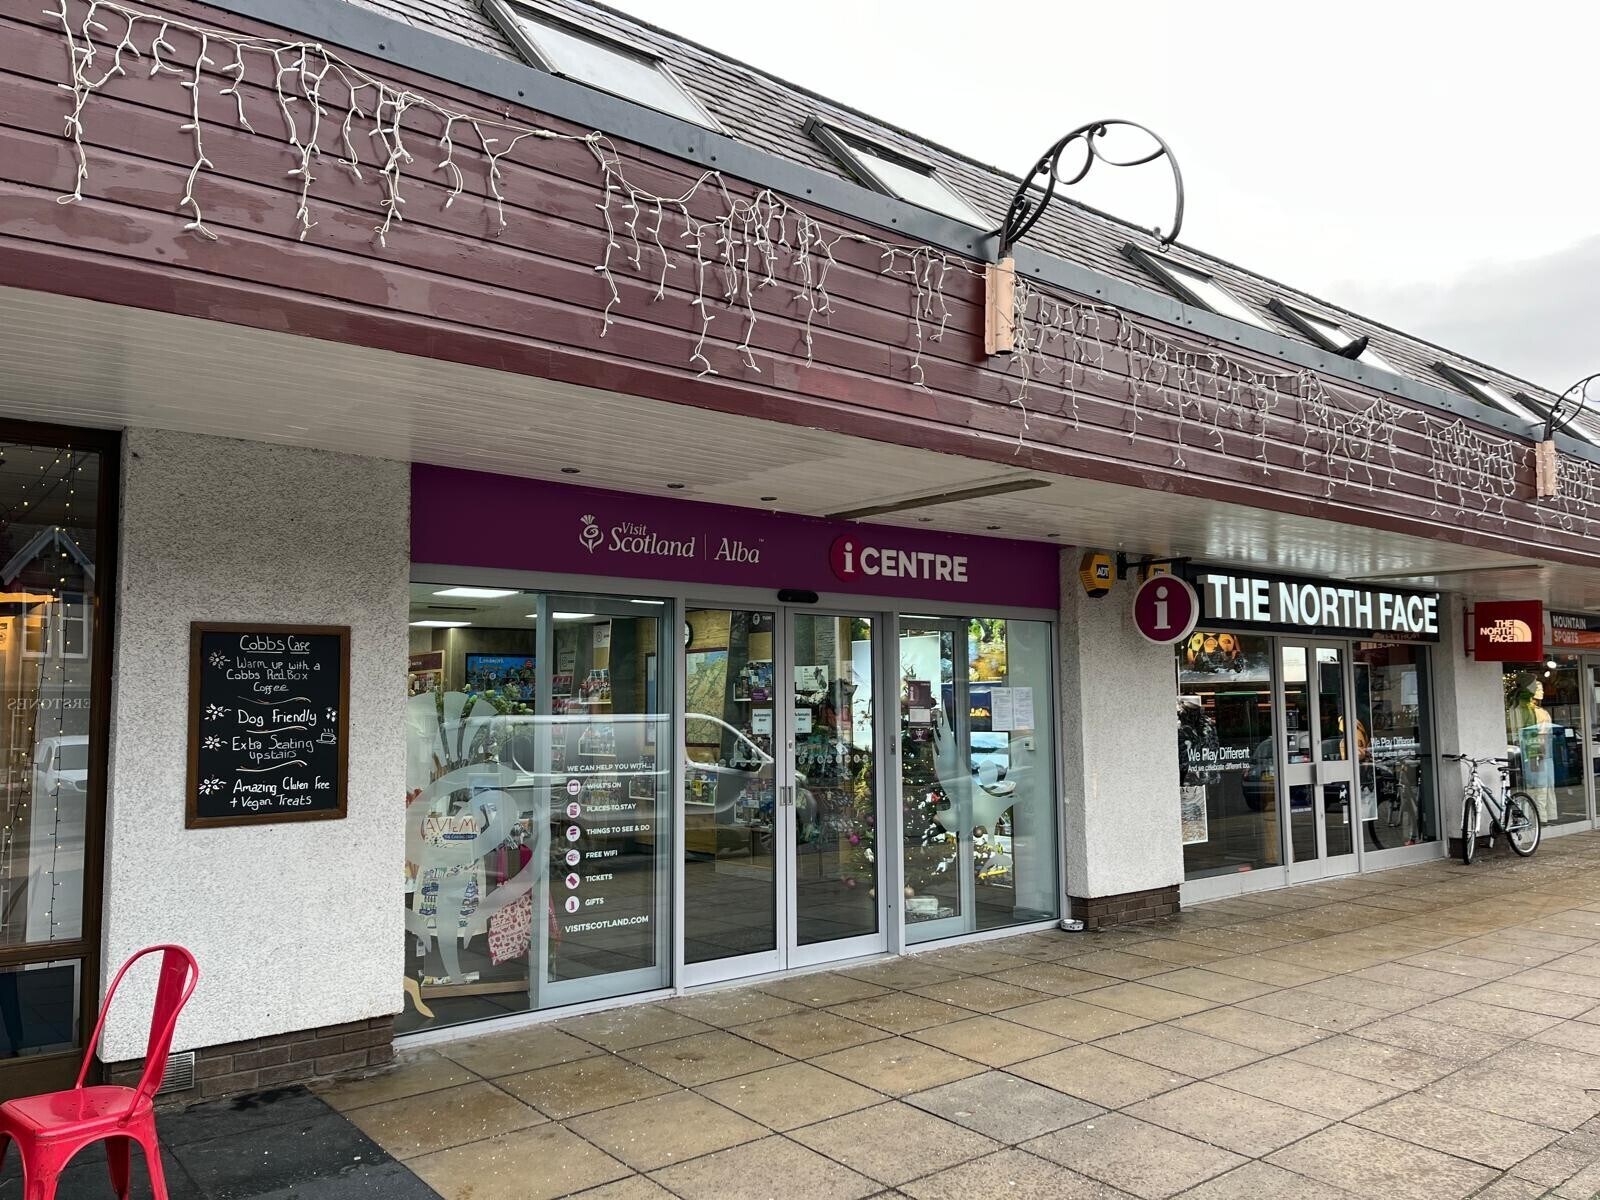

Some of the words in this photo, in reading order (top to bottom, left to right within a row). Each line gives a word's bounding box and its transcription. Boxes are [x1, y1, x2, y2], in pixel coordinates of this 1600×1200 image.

[622, 522, 647, 536] Visit
[608, 526, 696, 558] Scotland
[714, 538, 760, 563] Alba
[860, 546, 968, 583] CENTRE
[1096, 566, 1109, 577] ADT
[1207, 574, 1270, 622] THE
[1279, 582, 1372, 630] NORTH
[1379, 593, 1439, 634] FACE
[1494, 620, 1514, 628] THE
[1553, 615, 1587, 630] MOUNTAIN
[1480, 627, 1514, 635] NORTH
[1554, 630, 1579, 644] SPORTS
[240, 635, 285, 651] Cobbs
[1489, 635, 1514, 643] FACE
[236, 656, 268, 669] Warm
[271, 661, 284, 670] up
[289, 661, 310, 670] with
[313, 662, 321, 670] a
[226, 669, 261, 680] Cobbs
[267, 669, 286, 680] Red
[287, 670, 308, 680] Box
[253, 682, 290, 695] Coffee
[238, 709, 264, 727] Dog
[232, 736, 262, 751] Extra
[268, 735, 314, 753] Seating
[249, 750, 297, 764] upstairs
[1188, 748, 1200, 761] We
[1202, 748, 1218, 763] Play
[1219, 747, 1250, 760] Different
[233, 779, 277, 795] Amazing
[241, 796, 273, 810] Vegan
[276, 795, 312, 806] Treats
[585, 874, 613, 882] TICKETS
[585, 898, 604, 906] GIFTS
[565, 915, 649, 933] VISITSCOTLAND.COM
